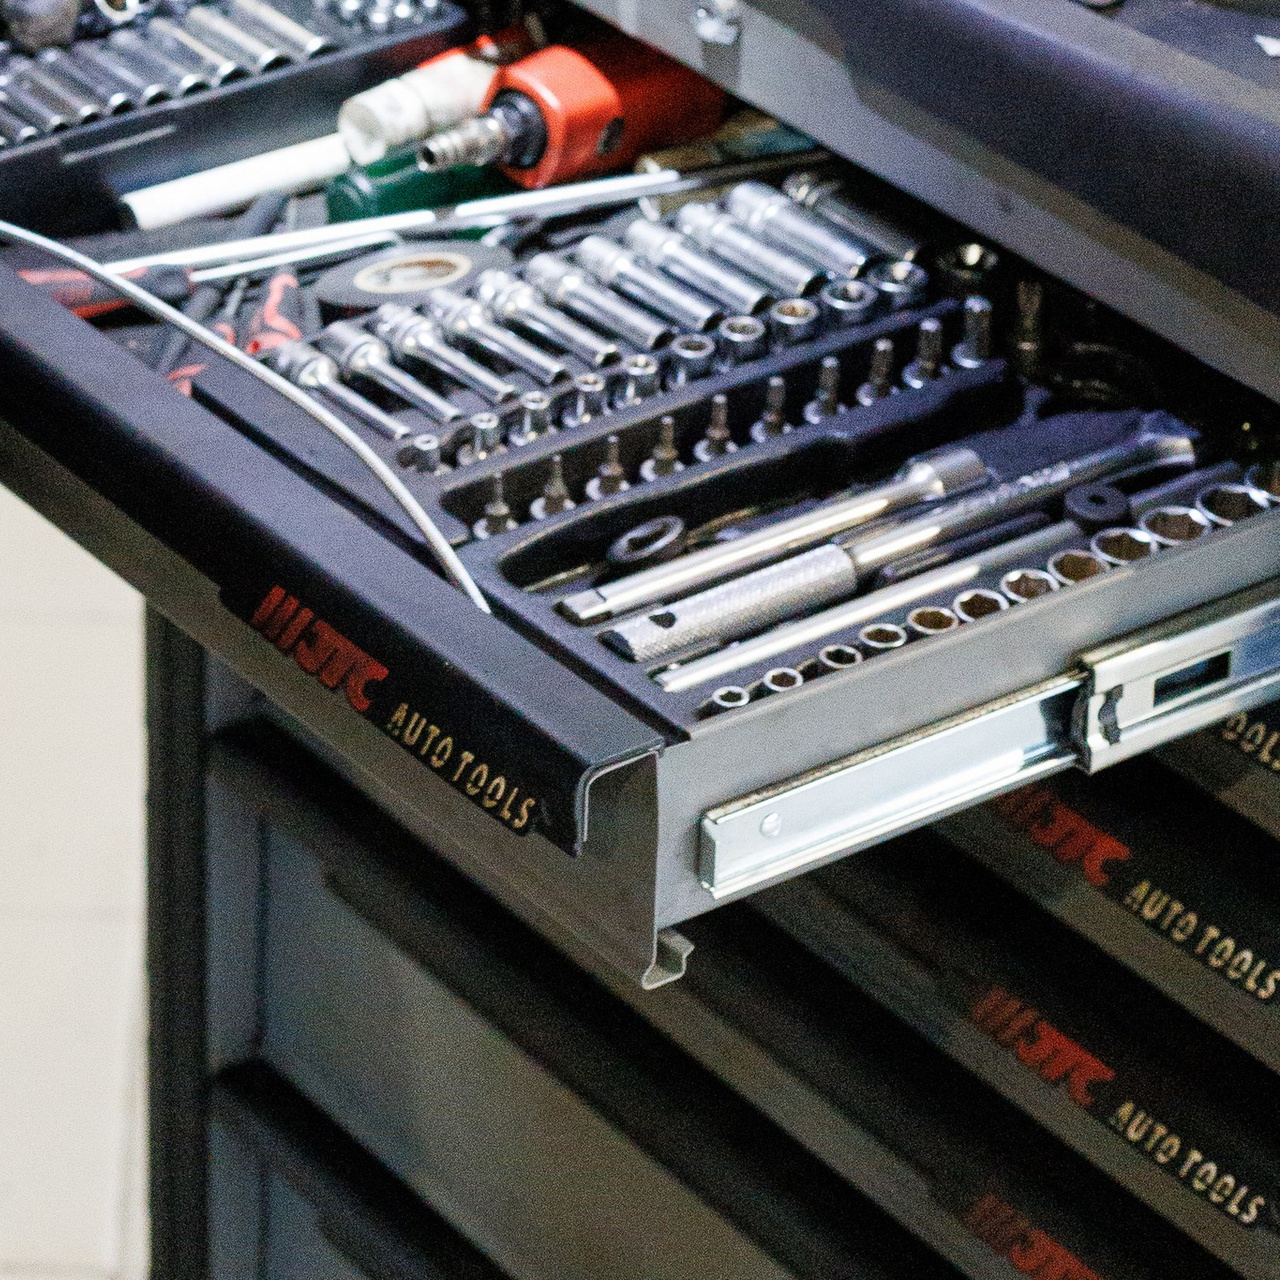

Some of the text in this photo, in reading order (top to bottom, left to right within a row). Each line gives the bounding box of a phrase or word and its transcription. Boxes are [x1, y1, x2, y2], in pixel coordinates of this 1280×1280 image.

[386, 702, 453, 768] AUTO
[451, 751, 536, 829] TOOLS
[1122, 879, 1198, 941] AUTO
[1194, 925, 1280, 1000] TOOLS
[1109, 1100, 1181, 1164] AUTO
[1178, 1149, 1265, 1224] TOOLS
